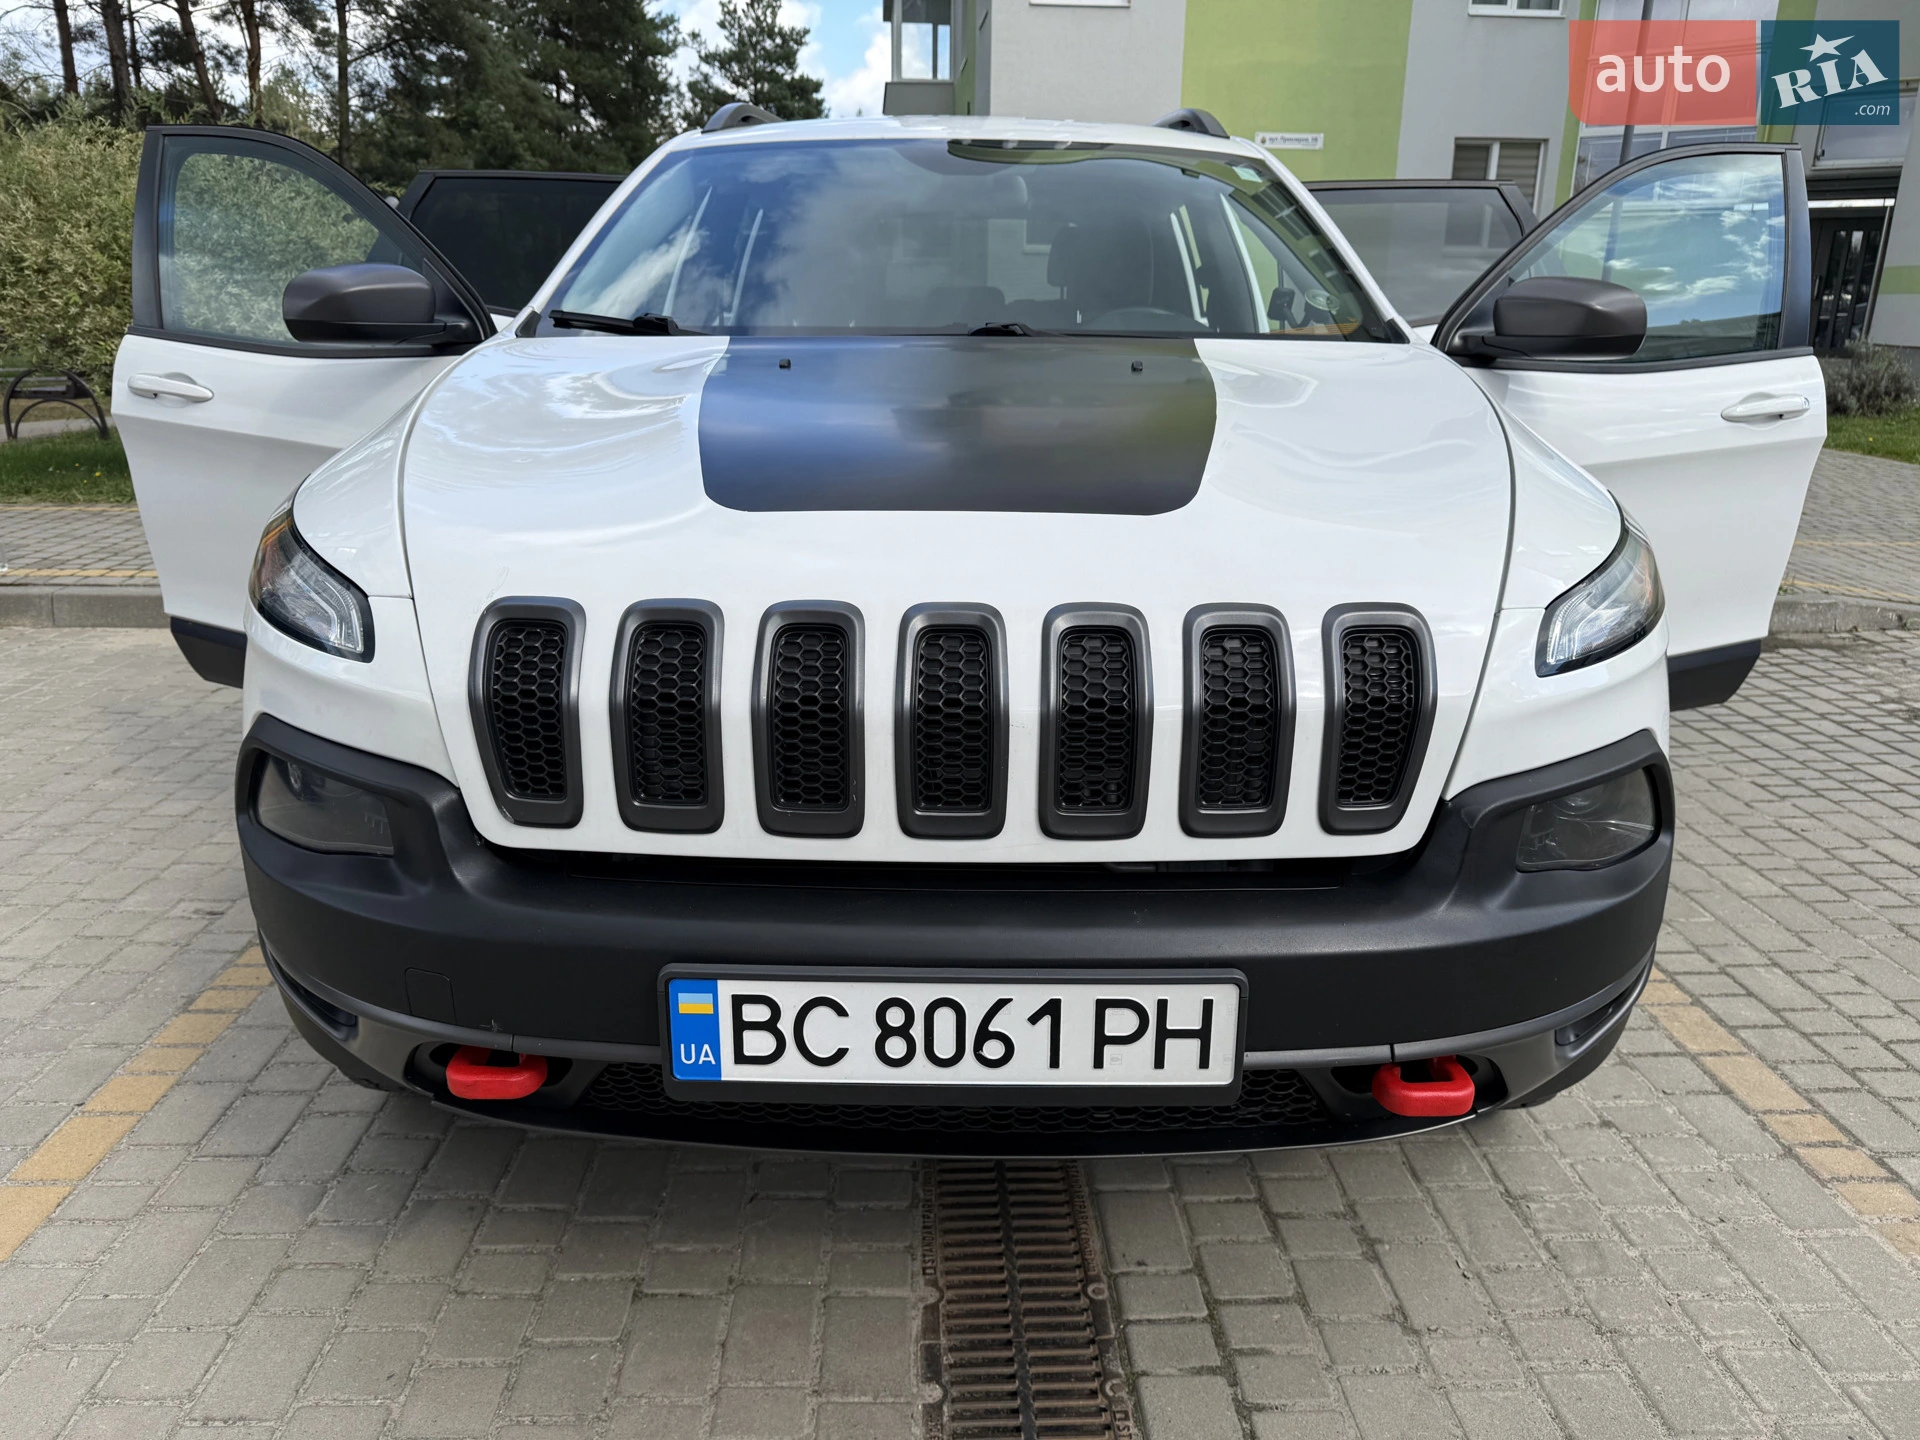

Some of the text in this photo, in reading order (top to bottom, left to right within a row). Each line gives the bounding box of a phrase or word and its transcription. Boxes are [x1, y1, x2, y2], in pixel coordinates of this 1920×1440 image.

[679, 1044, 717, 1065] UA
[731, 993, 1214, 1070] BC 8061 PH
